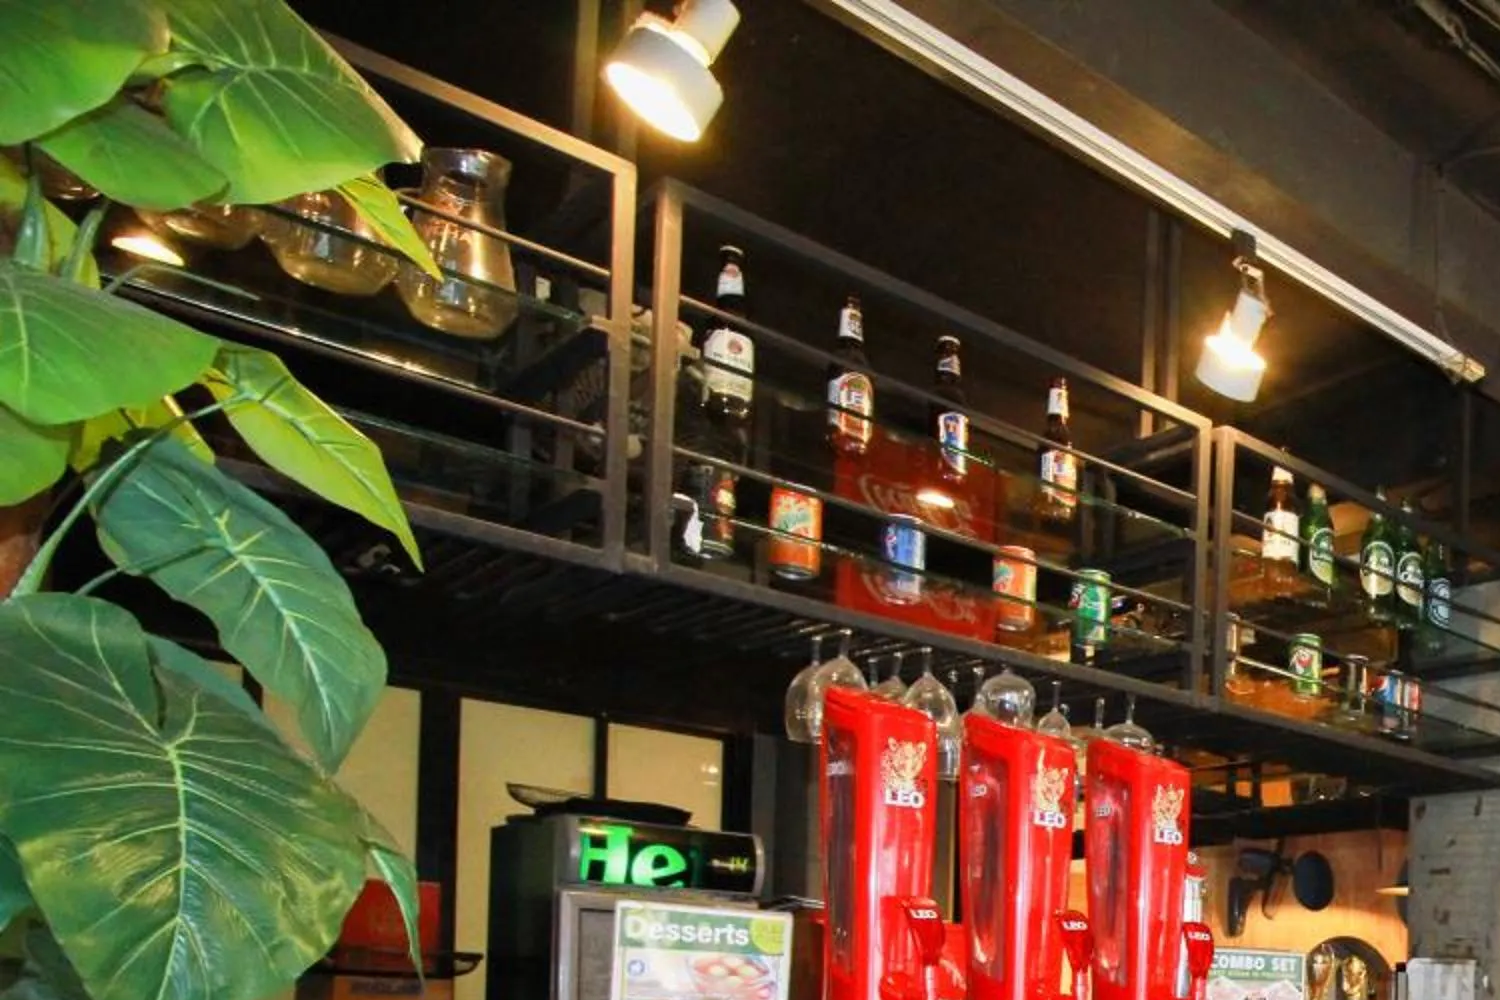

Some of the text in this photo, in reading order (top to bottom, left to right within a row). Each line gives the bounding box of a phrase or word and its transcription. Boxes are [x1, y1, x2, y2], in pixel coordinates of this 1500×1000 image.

[885, 784, 925, 808] LEO
[1033, 810, 1066, 829] LEO
[1153, 828, 1183, 845] LEO
[908, 908, 939, 919] LEO
[624, 914, 749, 946] Desserts
[1062, 920, 1088, 931] LEO
[1187, 931, 1211, 941] LEO
[1271, 958, 1297, 972] SET
